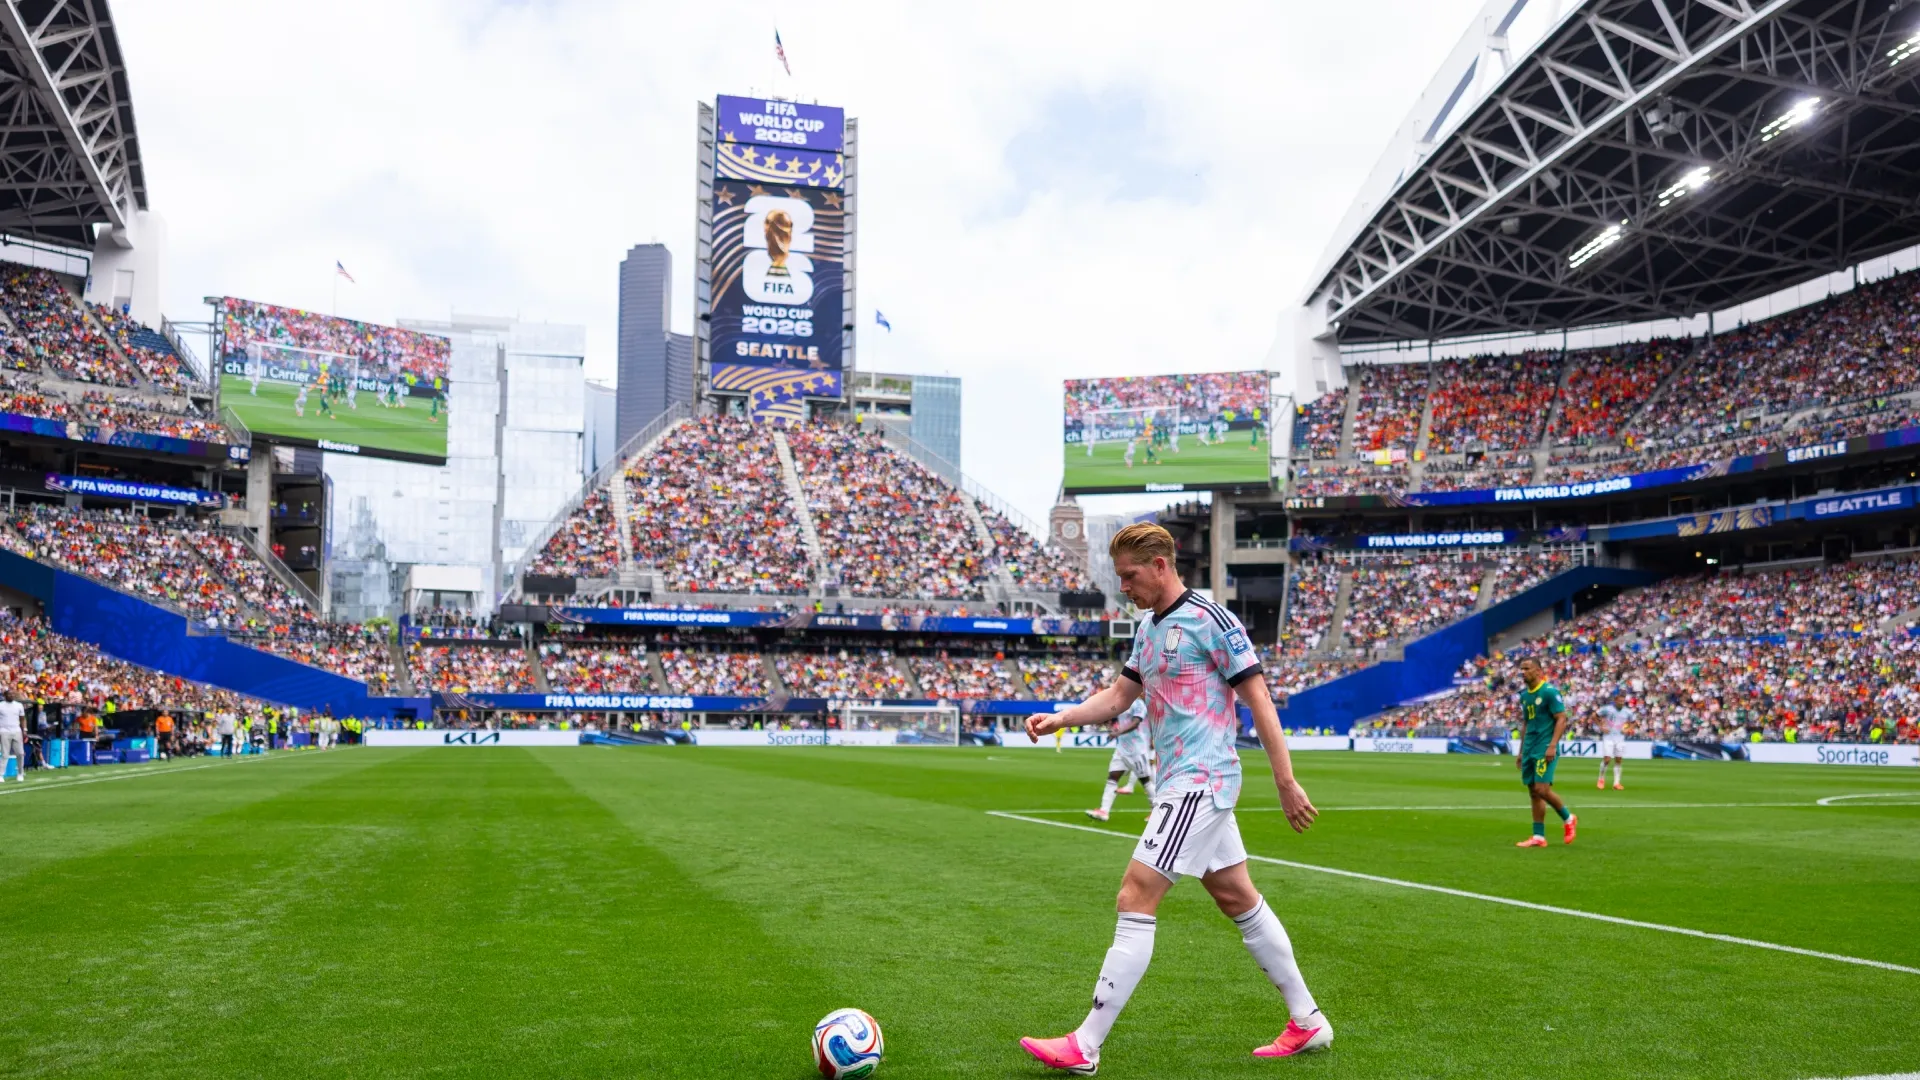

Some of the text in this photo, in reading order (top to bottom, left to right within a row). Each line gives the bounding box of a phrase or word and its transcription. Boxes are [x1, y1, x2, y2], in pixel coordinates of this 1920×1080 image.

[766, 101, 797, 117] FIFA
[739, 112, 824, 133] WORLD CUP
[755, 128, 807, 145] 2026
[764, 282, 794, 294] FIFA
[742, 304, 814, 320] WORLD CUP
[742, 317, 814, 337] 2026
[736, 341, 819, 361] SEATTLE
[269, 365, 310, 382] Carrier
[318, 438, 359, 453] Hisense
[1787, 440, 1847, 463] SEATTLE
[72, 479, 197, 502] FIFA WORLD CUP 2026
[1495, 477, 1632, 501] FIFA WORLD CUP 2026
[1815, 492, 1901, 515] SEATTLE
[1368, 532, 1504, 547] FIFA WORLD CUP 2026
[623, 611, 644, 621] FIFA
[644, 611, 678, 622] WORLD
[678, 612, 697, 622] CUP
[545, 695, 694, 709] FIFA WORLD CUP 2026
[444, 732, 500, 744] KIA
[767, 731, 831, 746] Sportage
[1372, 739, 1414, 752] Sportage
[1561, 742, 1597, 756] KIA
[1816, 745, 1888, 766] Sportage
[1157, 802, 1174, 835] 7
